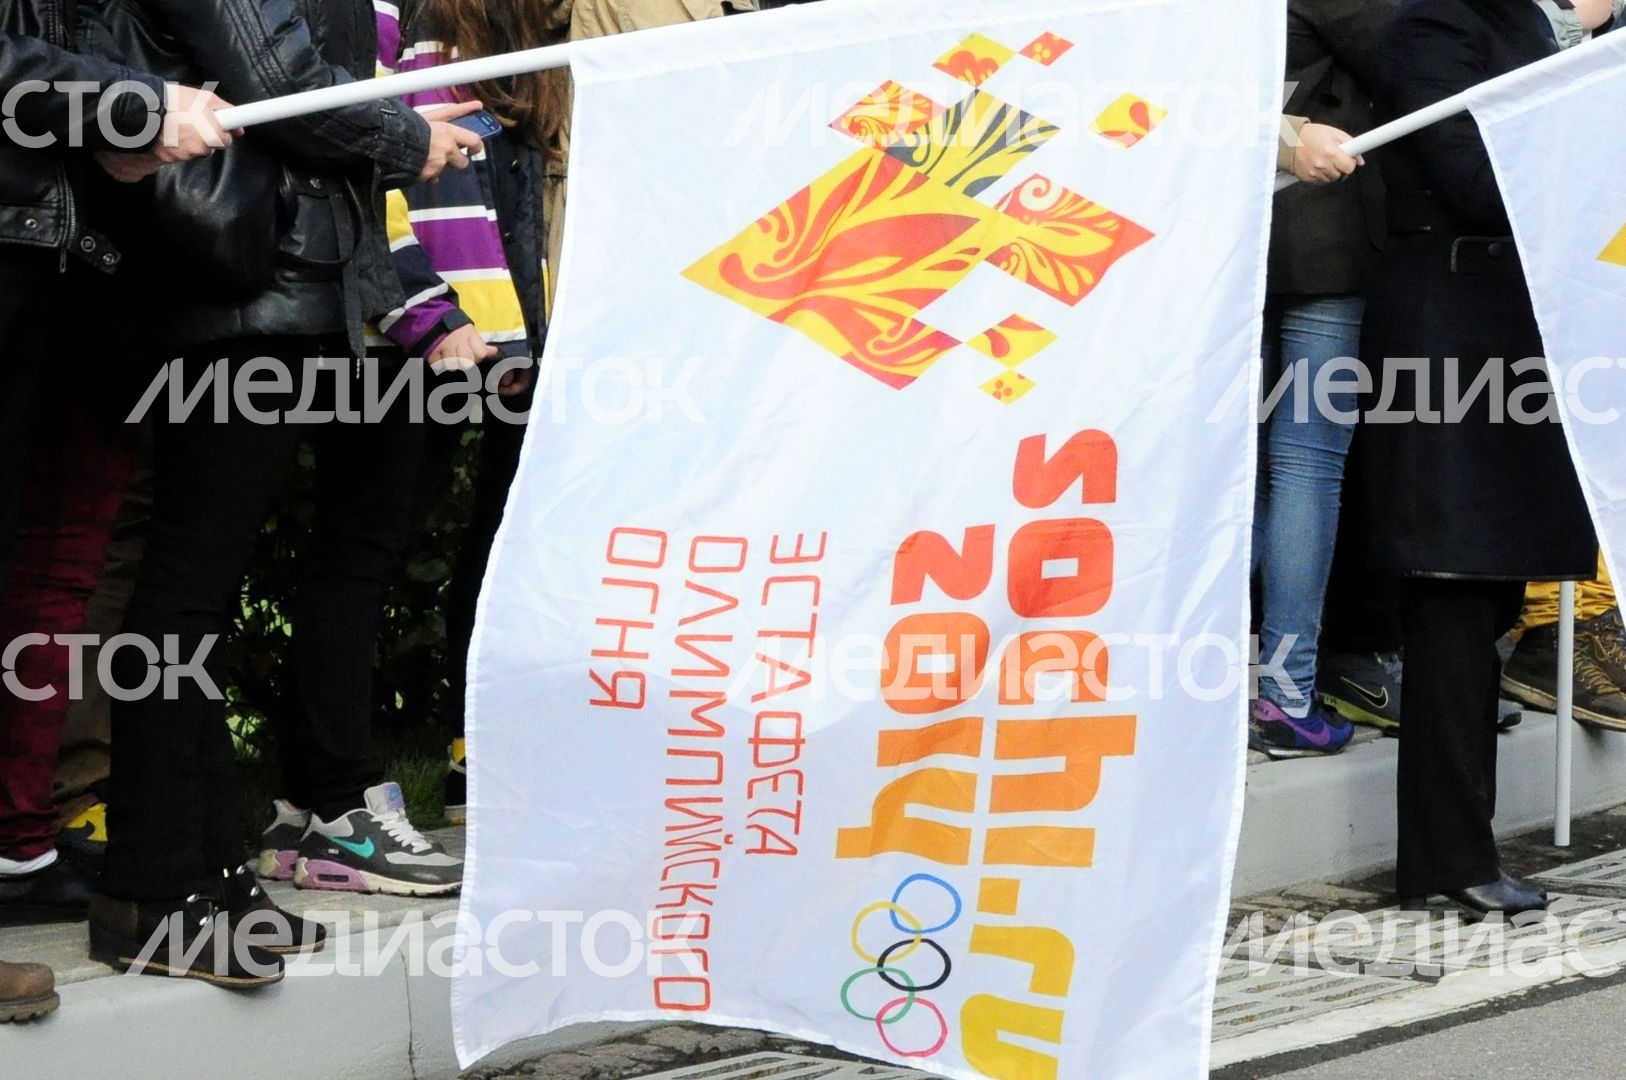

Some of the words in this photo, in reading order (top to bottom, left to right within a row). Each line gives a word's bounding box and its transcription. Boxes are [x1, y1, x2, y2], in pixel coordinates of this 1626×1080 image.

[588, 526, 668, 710] ОГНЯ
[648, 534, 749, 1012] ОЛИМПИЙСКОГО
[744, 530, 828, 857] ЭСТАФЕТА
[835, 523, 997, 868] 2014
[959, 428, 1138, 1080] sochi.ru
